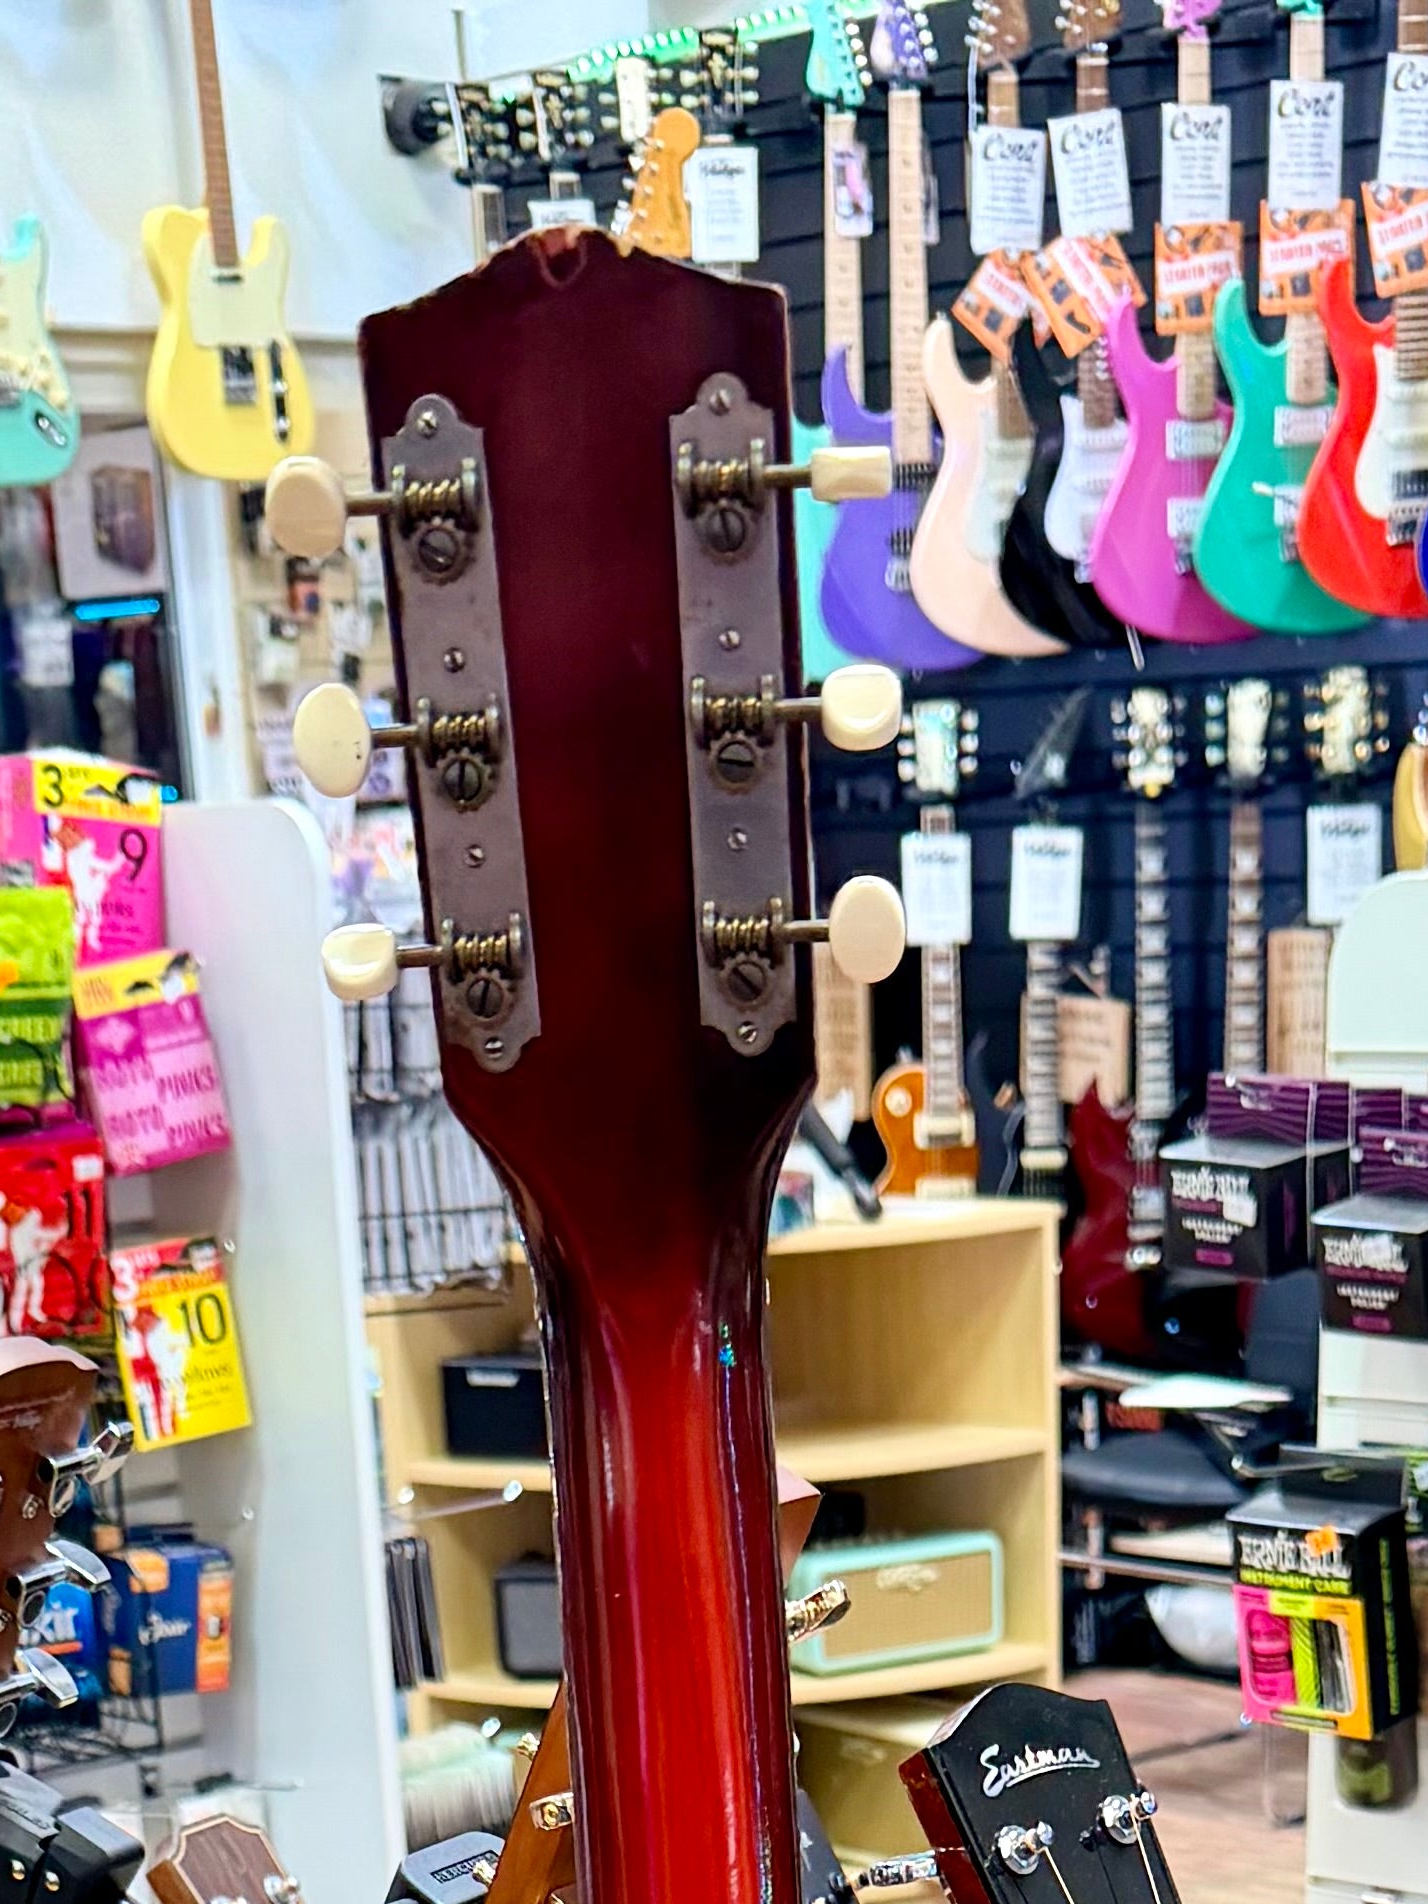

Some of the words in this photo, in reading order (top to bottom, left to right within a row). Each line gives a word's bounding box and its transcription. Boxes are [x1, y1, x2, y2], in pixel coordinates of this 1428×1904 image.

[41, 764, 64, 808] 3
[119, 829, 147, 881] 9
[111, 1253, 138, 1300] 3
[178, 1293, 226, 1348] 10
[1238, 1529, 1297, 1573] ERNIE
[980, 1744, 1100, 1797] Eastman
